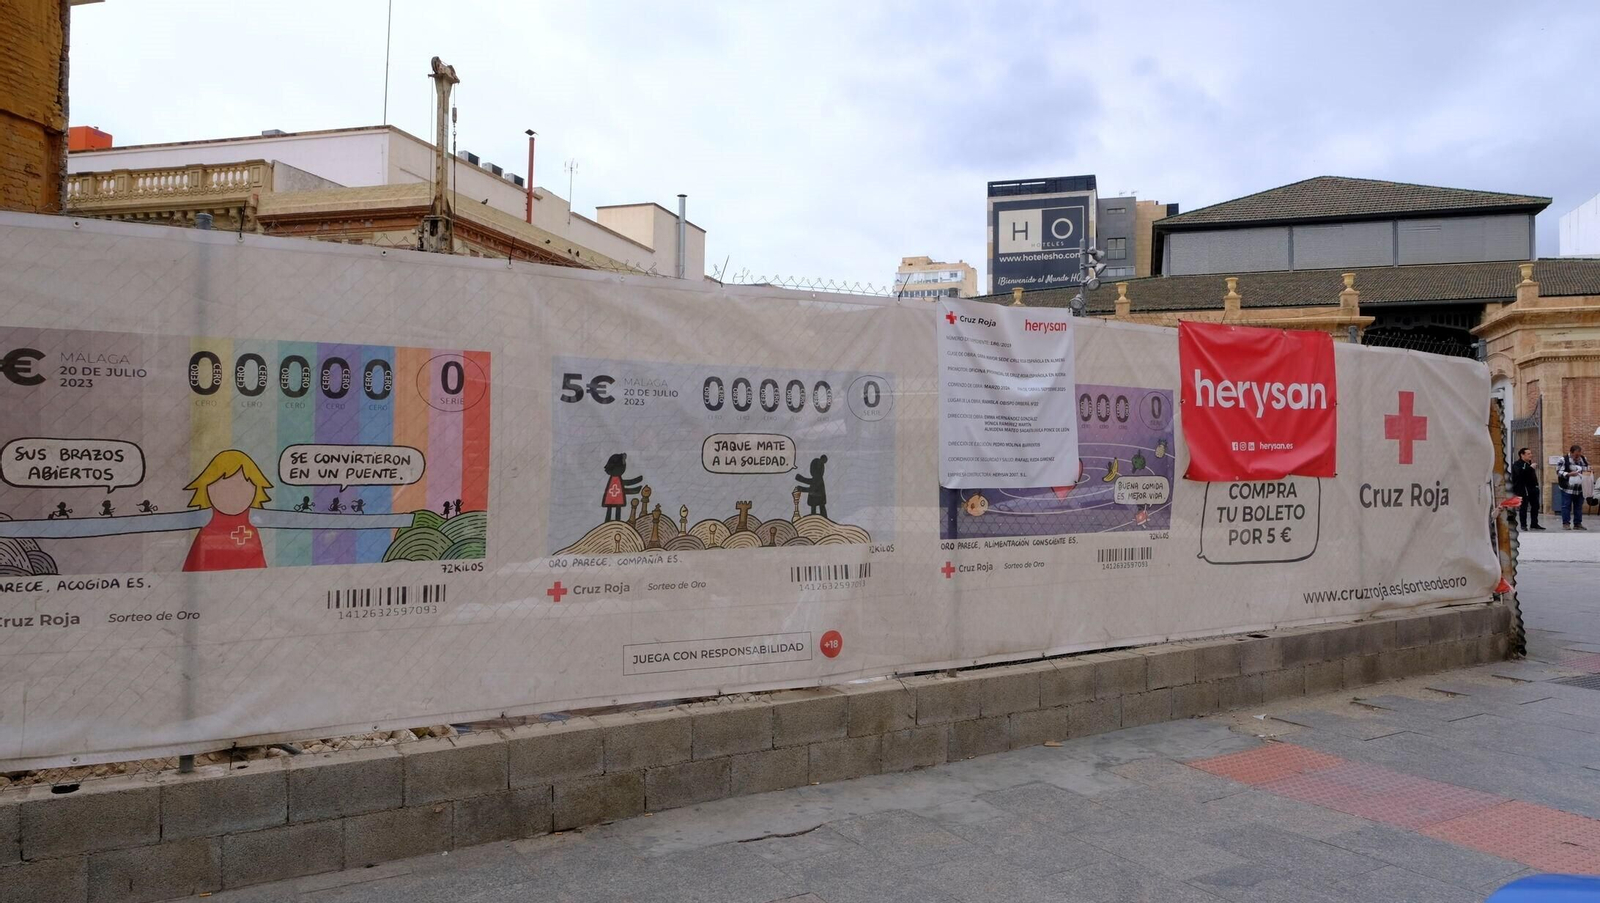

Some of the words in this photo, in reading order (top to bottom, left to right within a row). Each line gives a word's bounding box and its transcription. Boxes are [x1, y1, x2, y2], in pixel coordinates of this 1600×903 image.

[1045, 275, 1069, 284] Mundo
[959, 315, 976, 324] Cruz
[978, 318, 997, 327] Roja
[1025, 319, 1067, 334] herysan
[60, 366, 77, 375] 20
[82, 367, 101, 376] DE
[106, 367, 147, 378] JULIO
[191, 364, 199, 386] CERO
[213, 363, 222, 386] CERO
[237, 366, 245, 387] CERO
[259, 365, 267, 387] CERO
[281, 367, 289, 389] CERO
[302, 367, 310, 388] CERO
[322, 369, 330, 390] CERO
[343, 368, 351, 390] CERO
[441, 360, 464, 395] 0
[60, 378, 93, 388] 2023
[365, 371, 373, 391] CERO
[624, 388, 635, 396] 20
[637, 389, 650, 397] DE
[653, 389, 679, 398] JULIO
[863, 381, 880, 408] 0
[1194, 369, 1327, 418] herysan
[440, 397, 464, 405] SERIE
[624, 398, 645, 406] 2023
[714, 440, 751, 452] JAQUE
[757, 440, 785, 451] MATE
[1259, 441, 1293, 451] herysan.es
[15, 446, 47, 461] SUS
[60, 448, 124, 462] BRAZOS
[290, 452, 308, 464] SE
[712, 455, 720, 466] A
[725, 456, 736, 466] LA
[741, 456, 789, 467] SOLEDAD.
[290, 468, 310, 479] EN
[318, 468, 339, 479] UN
[346, 468, 403, 480] PUENTE.
[1118, 482, 1139, 491] BUENA
[1229, 482, 1297, 500] COMPRA
[1117, 492, 1125, 500] ES
[1128, 492, 1147, 501] MEJOR
[1360, 483, 1404, 508] Cruz
[1411, 480, 1449, 513] Roja
[1217, 506, 1238, 523] TU
[1242, 504, 1306, 523] BOLETO
[1228, 528, 1262, 546] POR
[940, 542, 955, 551] ORO
[549, 559, 568, 568] ORO
[572, 557, 611, 568] PARECE,
[958, 564, 976, 573] Cruz
[977, 562, 994, 572] Roja
[1003, 561, 1024, 570] Sorteo
[1024, 561, 1032, 569] de
[1033, 561, 1045, 569] Oro
[127, 578, 151, 588] ES.
[573, 585, 601, 595] Cruz
[604, 582, 630, 595] Roja
[647, 582, 675, 591] Sorteo
[678, 581, 689, 590] de
[690, 580, 707, 589] Oro
[1303, 576, 1468, 605] www.cruzroja.es/sorteodeoro
[0, 616, 34, 628] ruz
[40, 612, 80, 628] Roja
[108, 612, 152, 623] Sorteo
[156, 611, 172, 621] de
[177, 610, 200, 620] Oro
[338, 605, 438, 620] 1412632597093
[824, 639, 839, 650] +18
[633, 653, 671, 665] JUEGA
[673, 650, 698, 661] CON
[701, 642, 804, 659] RESPONSABILIDAD
